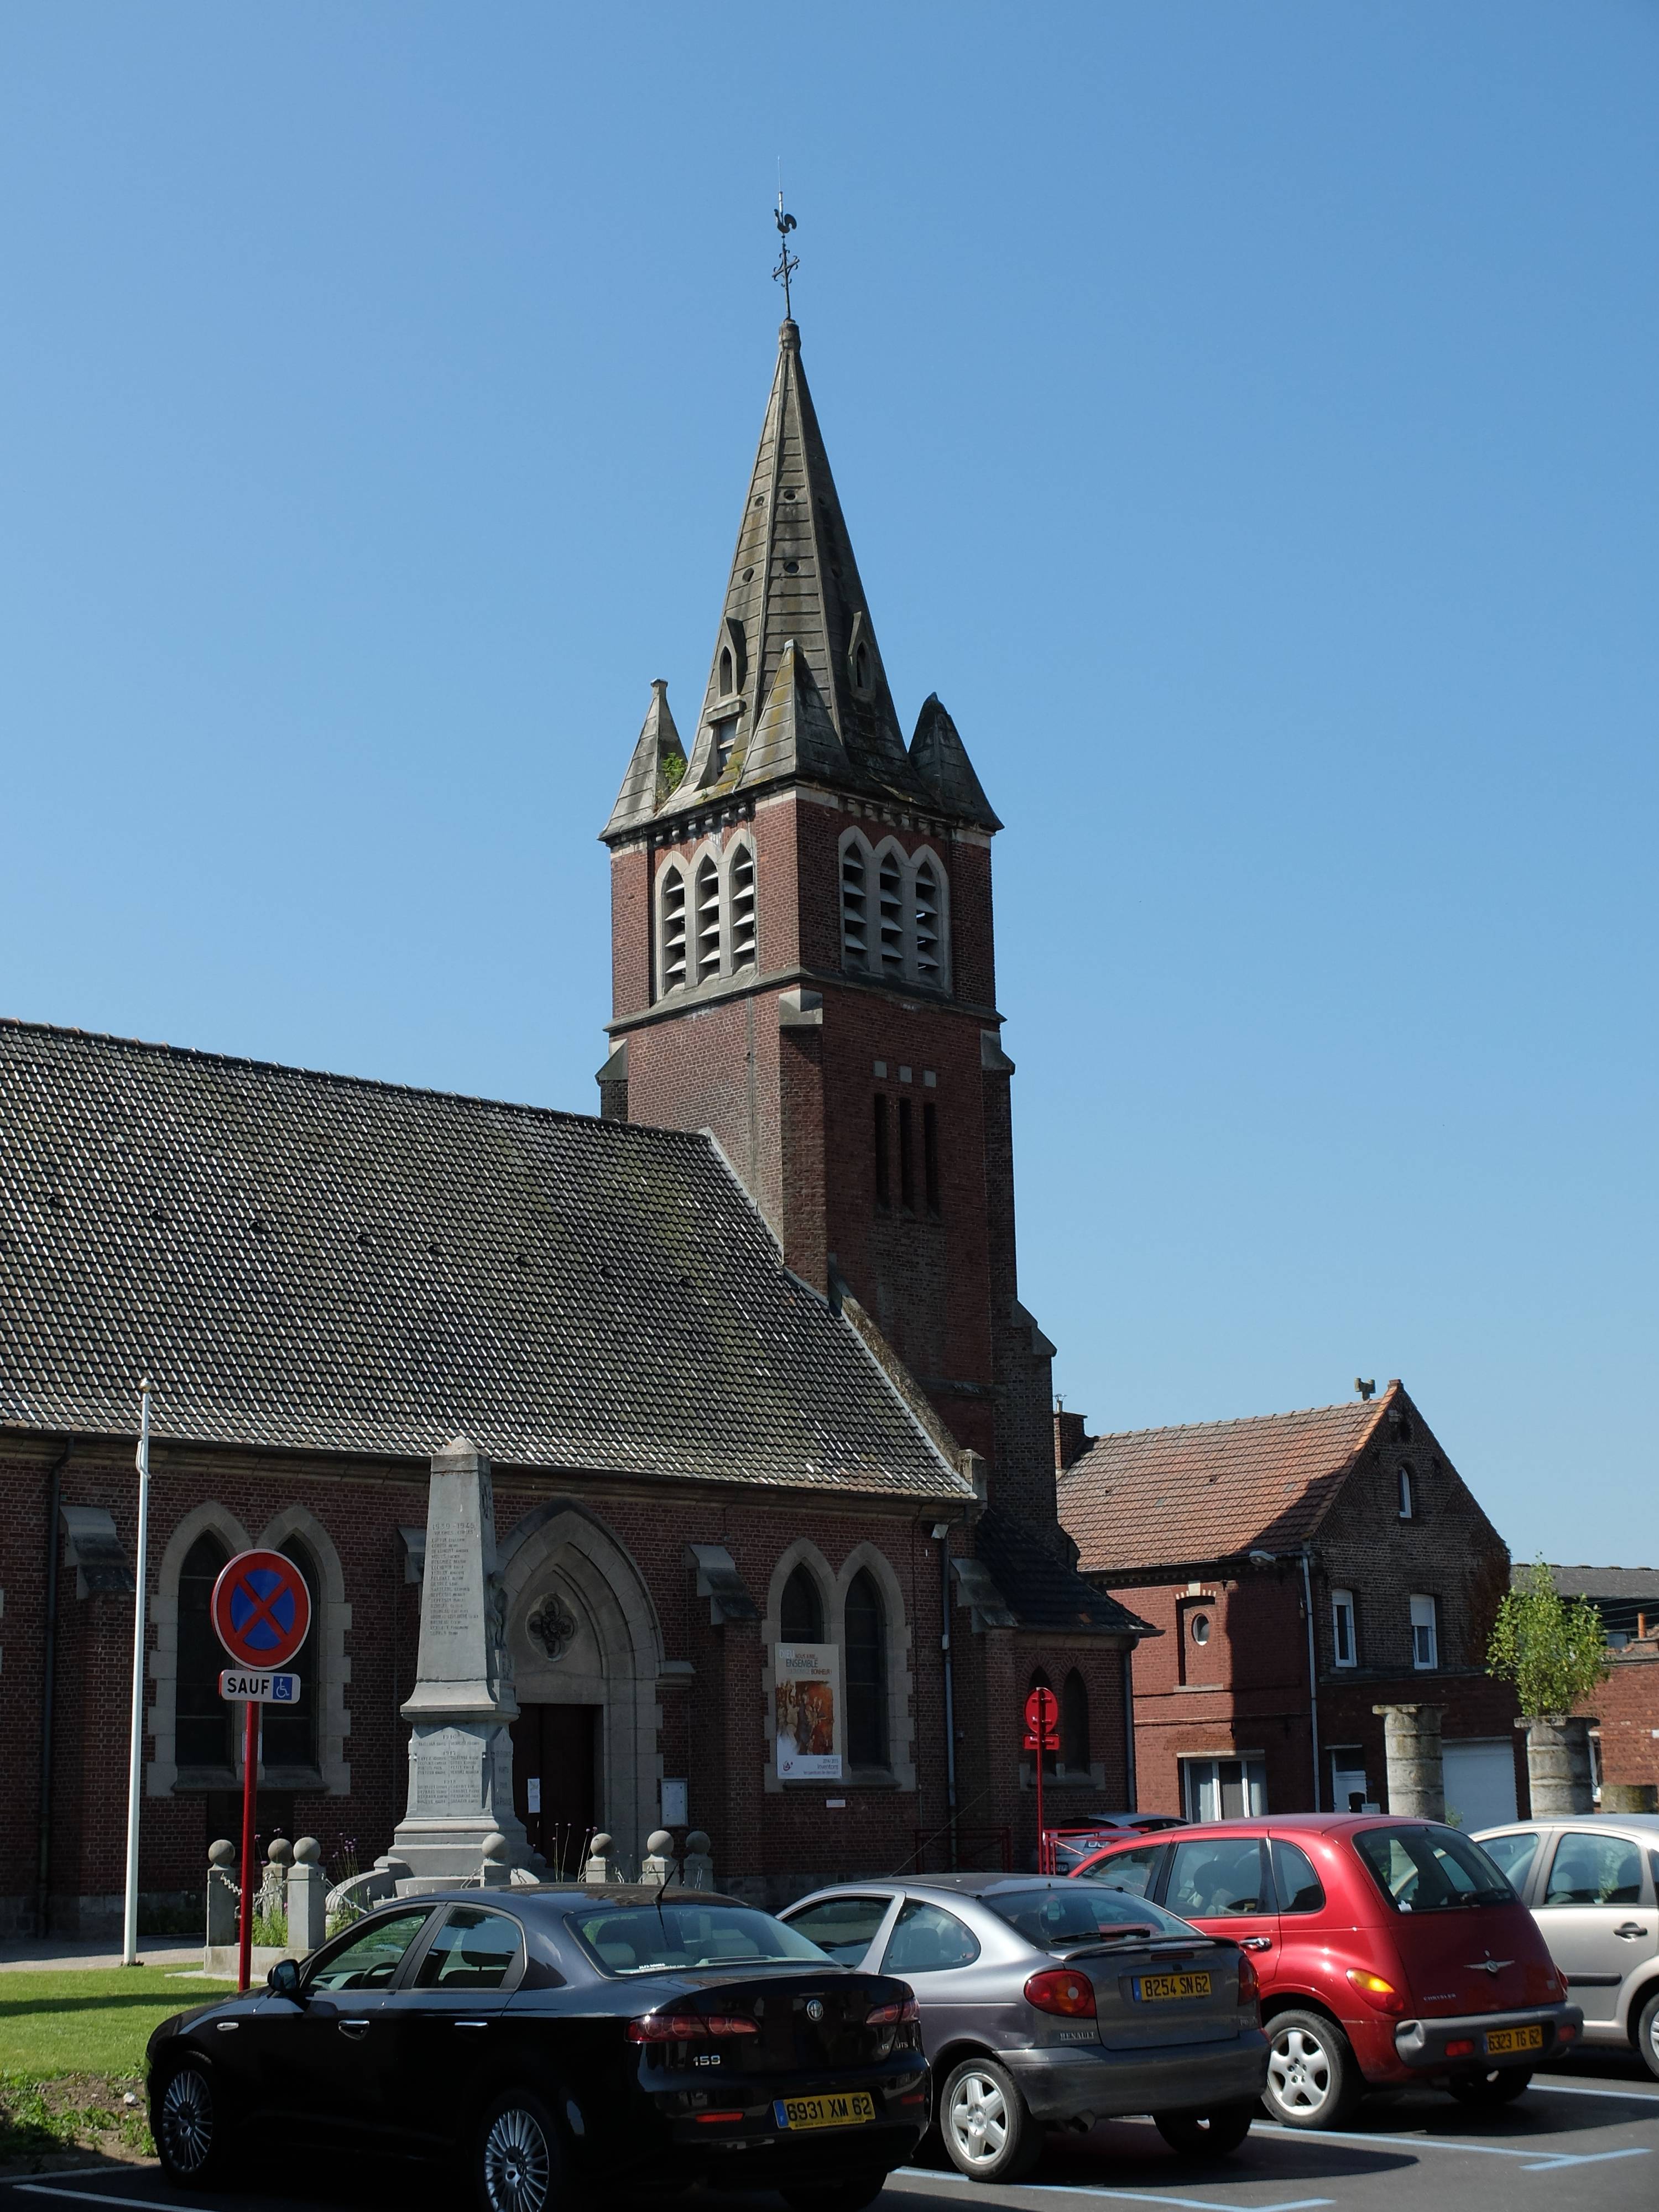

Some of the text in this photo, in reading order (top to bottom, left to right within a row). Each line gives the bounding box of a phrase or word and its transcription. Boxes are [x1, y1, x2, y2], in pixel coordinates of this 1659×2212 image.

[779, 1649, 795, 1659] DIEU
[786, 1658, 818, 1668] ENSEMBLE
[227, 1677, 270, 1695] SAUF
[1145, 1975, 1209, 1997] 8254 SN 62
[1060, 2031, 1094, 2041] RENAULT
[1488, 2033, 1512, 2051] 6323
[693, 2055, 721, 2067] 159
[786, 2100, 824, 2121] 6931
[827, 2098, 849, 2118] XM
[852, 2096, 872, 2116] 62
